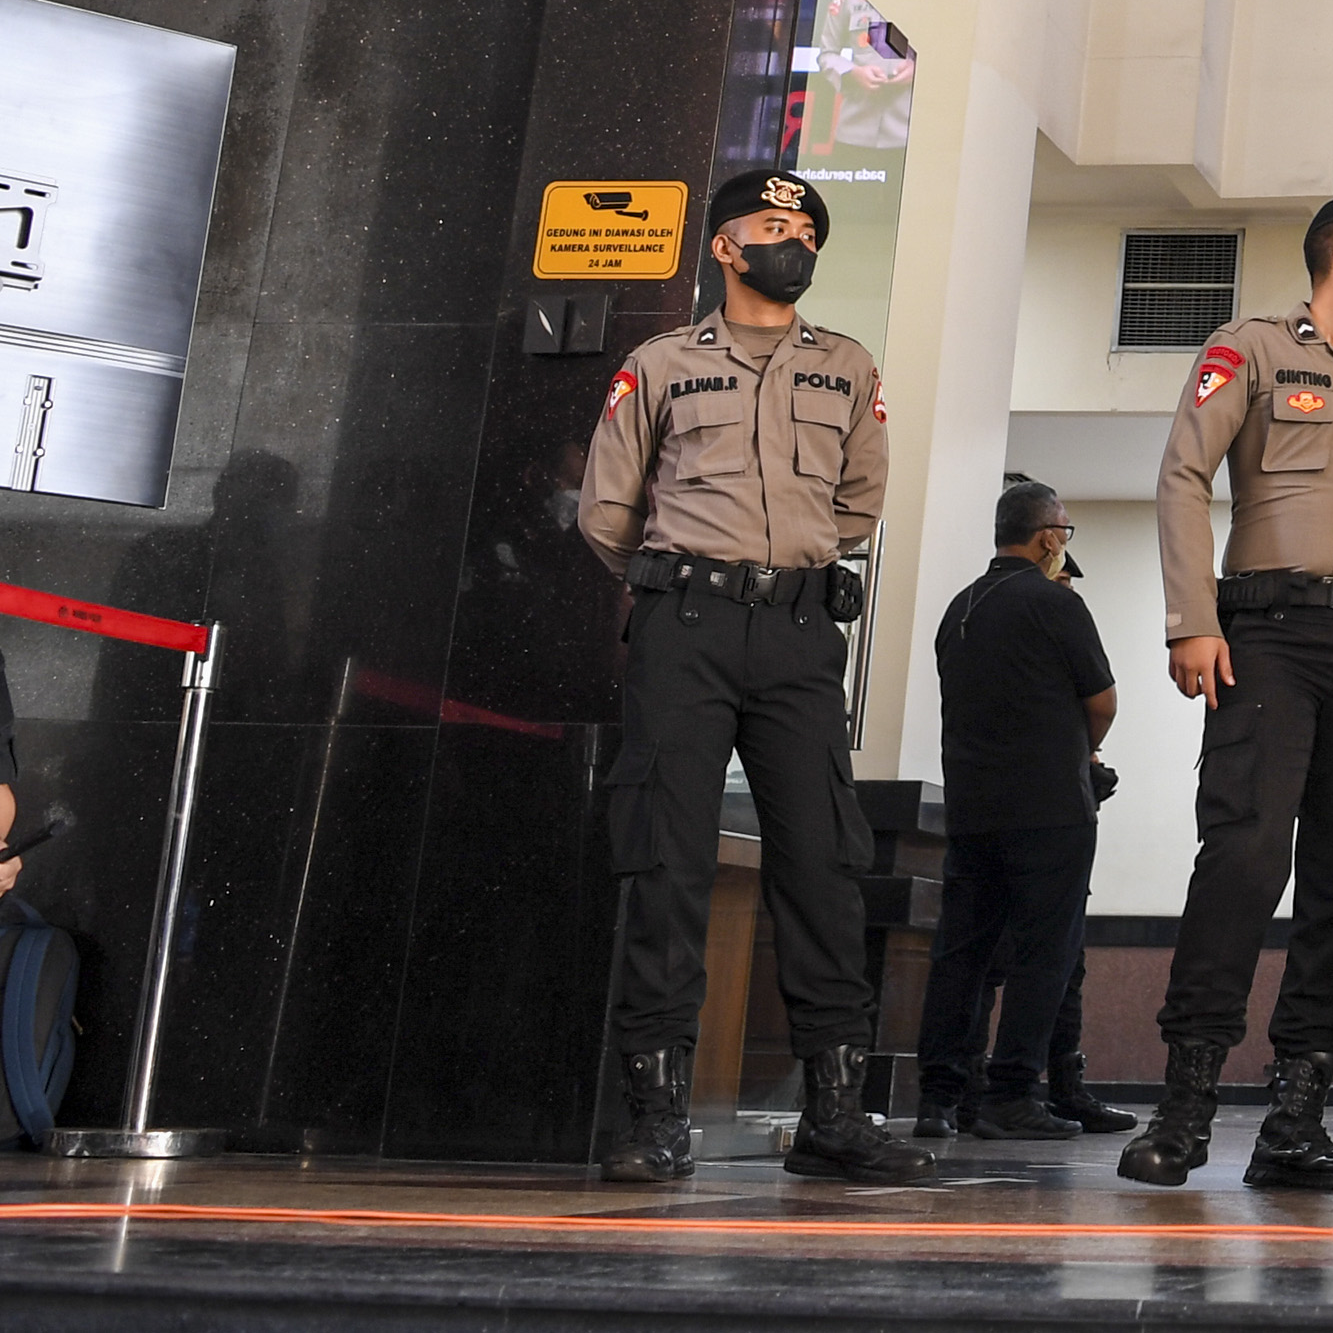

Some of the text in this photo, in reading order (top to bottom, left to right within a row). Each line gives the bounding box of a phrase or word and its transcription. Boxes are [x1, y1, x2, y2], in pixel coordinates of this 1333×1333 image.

[546, 228, 674, 238] GEDUNG INI DIAWASI OLEH
[550, 243, 665, 253] KAMERA SURVEILLANCE
[588, 259, 623, 268] 24 JAM
[1275, 368, 1332, 388] GINTING
[793, 372, 850, 397] POLRI
